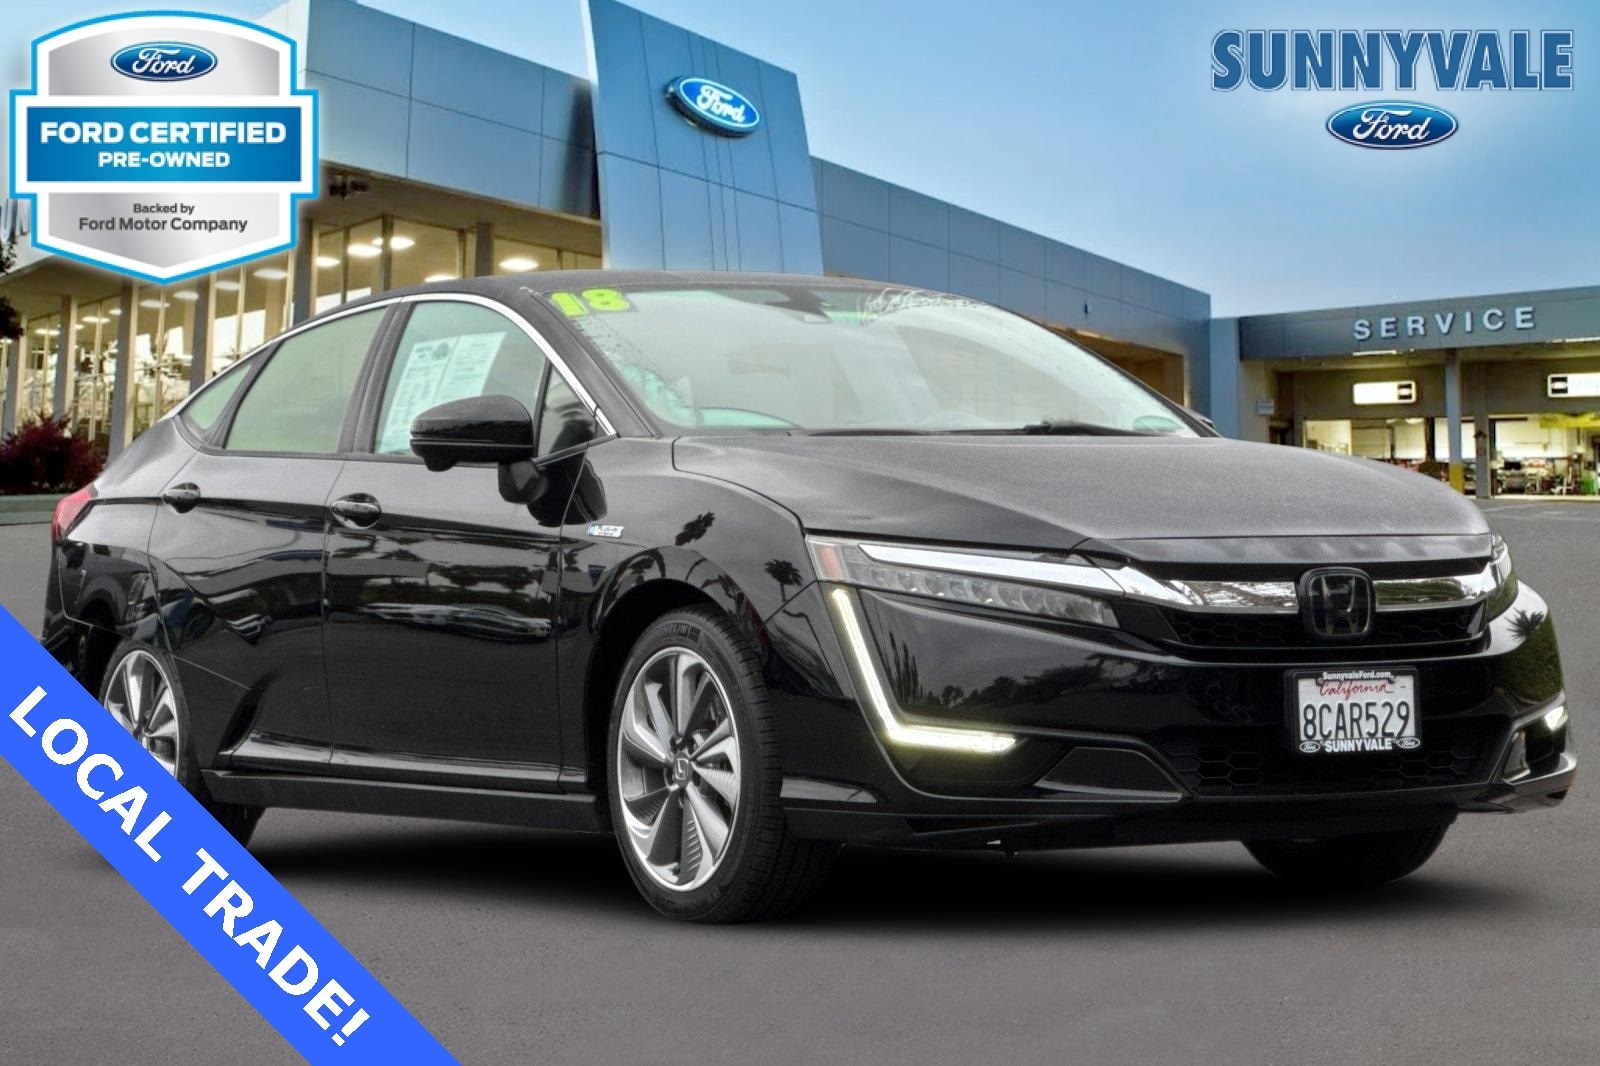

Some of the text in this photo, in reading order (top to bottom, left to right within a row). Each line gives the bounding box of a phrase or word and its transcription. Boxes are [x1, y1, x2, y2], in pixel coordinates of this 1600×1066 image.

[696, 84, 746, 123] Ford
[551, 288, 630, 317] 18
[1353, 306, 1536, 340] SERVICE
[1319, 680, 1395, 701] California
[1303, 701, 1410, 740] 8CAR529
[1325, 738, 1393, 753] SUNNYVALE
